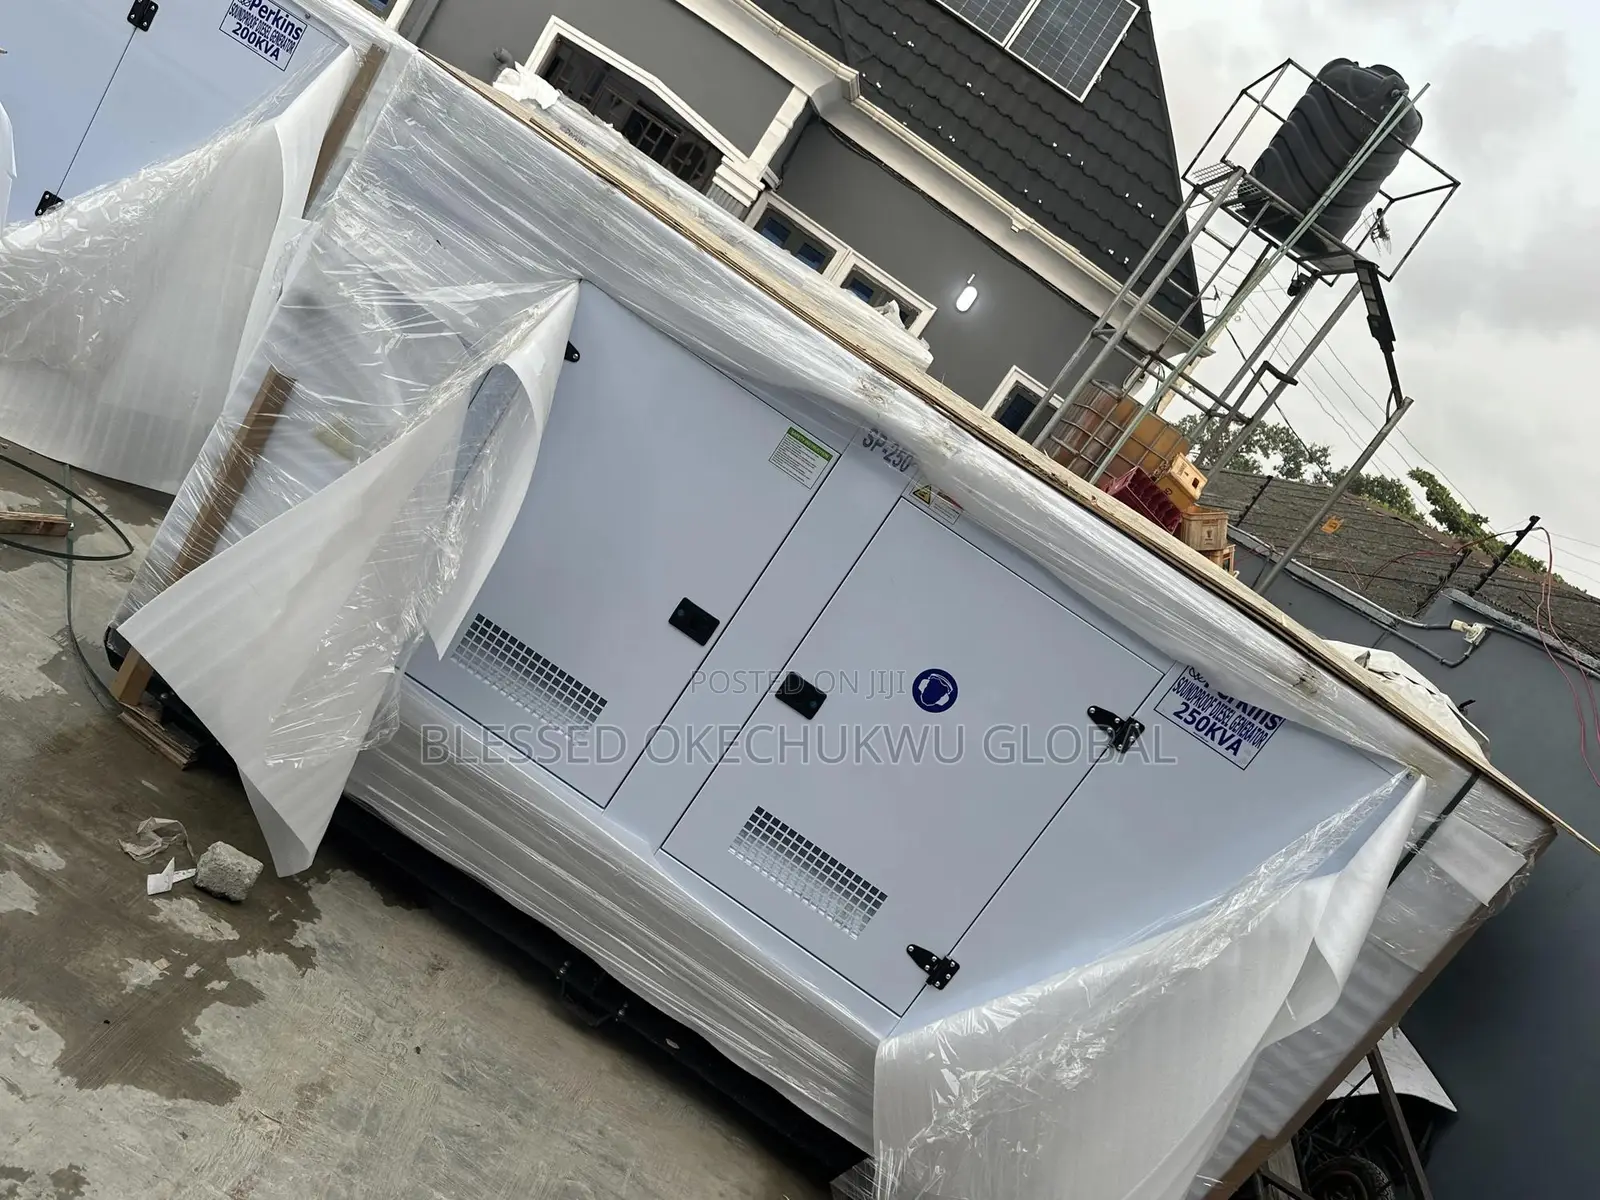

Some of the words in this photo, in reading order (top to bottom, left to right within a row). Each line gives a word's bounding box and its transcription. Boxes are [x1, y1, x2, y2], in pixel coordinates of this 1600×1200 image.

[232, 22, 280, 61] 200KVA
[249, 0, 303, 40] Perkins
[863, 428, 914, 472] SP-250
[1172, 677, 1218, 713] SOUNDPROOF
[1209, 700, 1236, 727] DIESEL
[1228, 714, 1269, 749] GENERATOR
[1173, 702, 1243, 756] 250KVA
